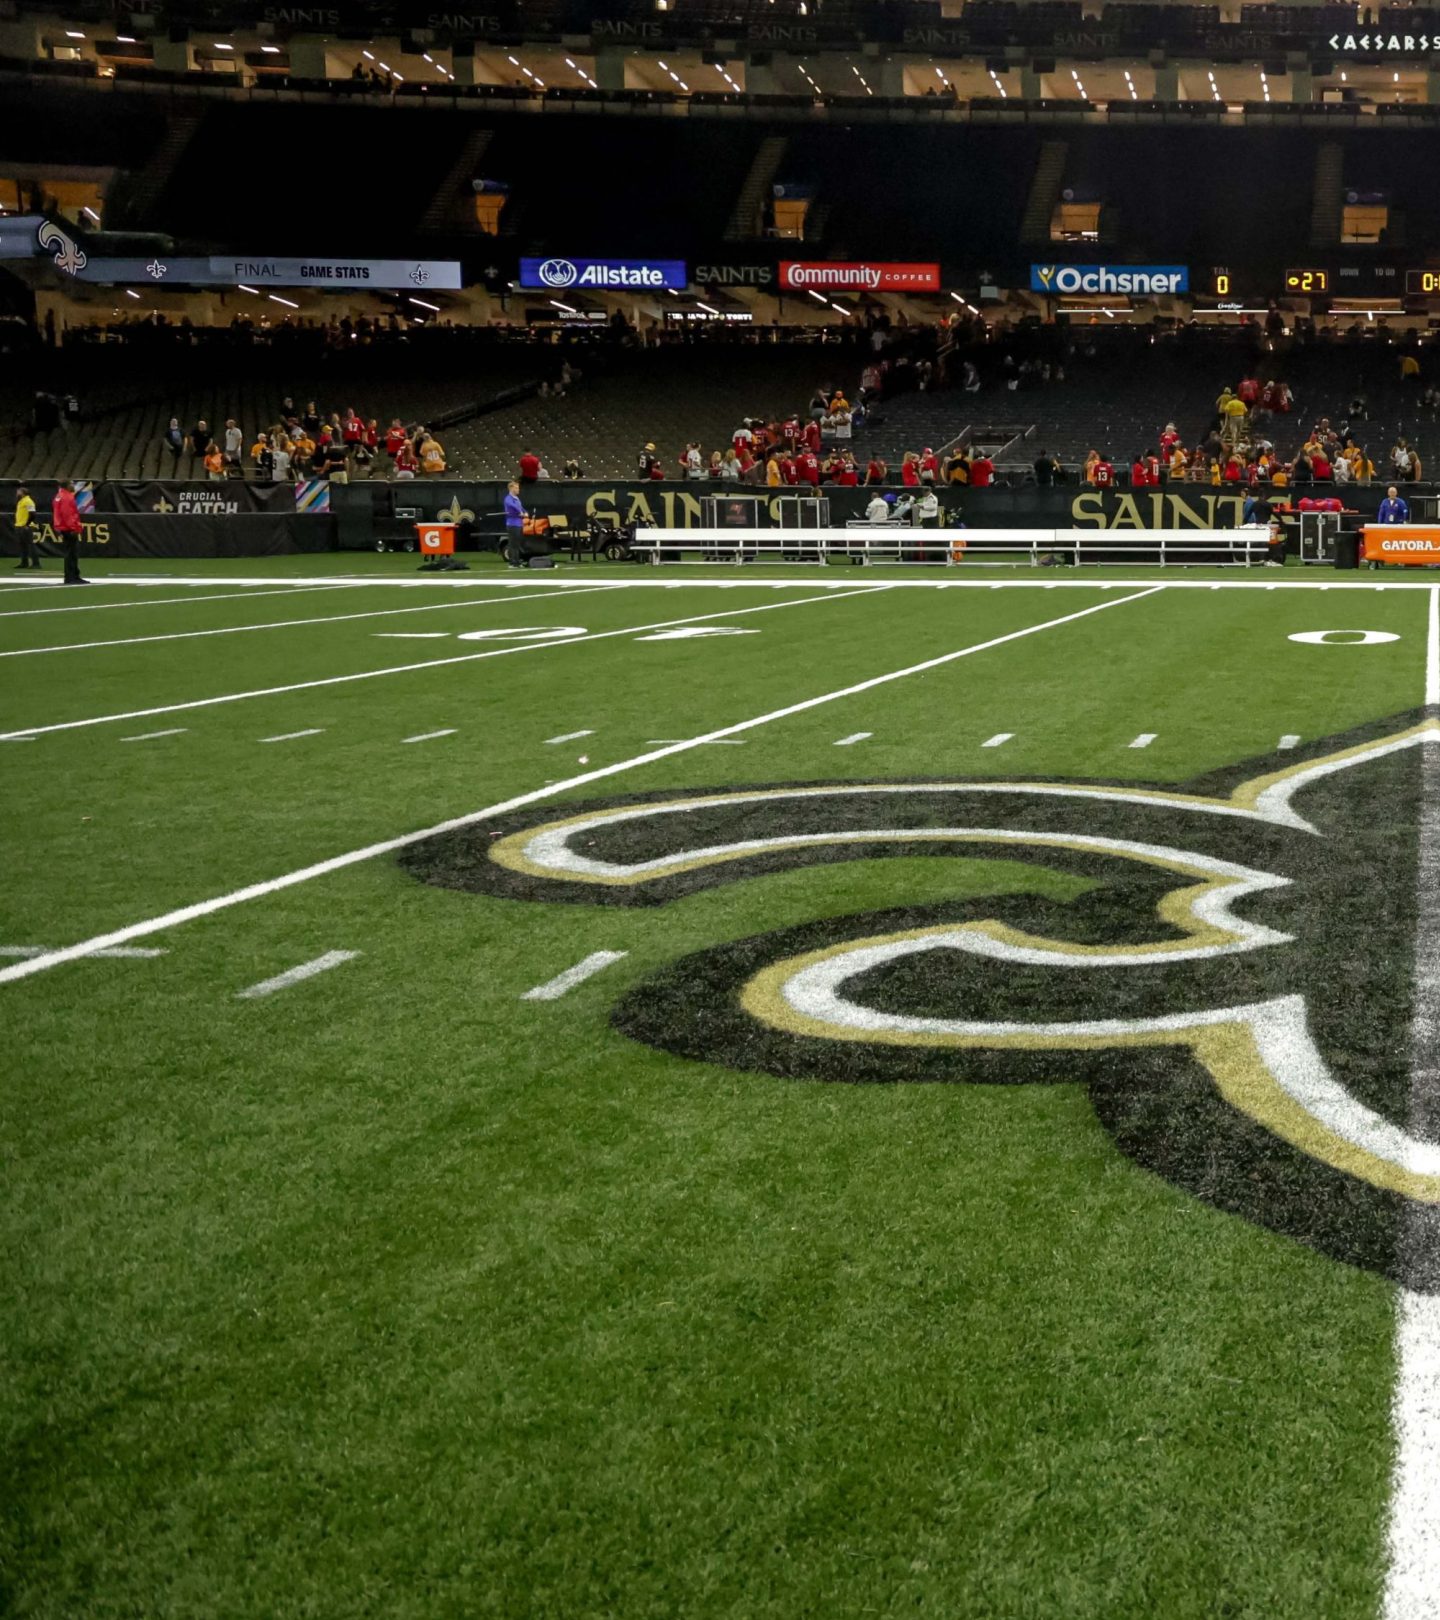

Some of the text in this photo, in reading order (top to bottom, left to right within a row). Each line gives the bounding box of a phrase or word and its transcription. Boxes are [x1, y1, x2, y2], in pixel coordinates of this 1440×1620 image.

[264, 7, 340, 26] SAINTS
[426, 14, 501, 33] SAINTS
[592, 19, 664, 37] SAINTS
[750, 25, 817, 42] SAINTS
[903, 28, 971, 46] SAINTS
[1204, 35, 1272, 50] SAINTS
[1328, 34, 1430, 51] CAESARS
[234, 263, 370, 279] FINAL GAME STATS
[578, 264, 664, 285] Allstate
[695, 265, 772, 284] SAINTS
[787, 264, 932, 288] Community COFFEE
[1056, 266, 1182, 294] Ochsner
[1217, 275, 1229, 294] 0
[1301, 272, 1326, 290] 27
[1098, 471, 1108, 482] 13
[180, 492, 222, 501] CRUCIAL
[178, 502, 238, 514] CATCH
[29, 521, 110, 544] SATS
[424, 530, 440, 547] G
